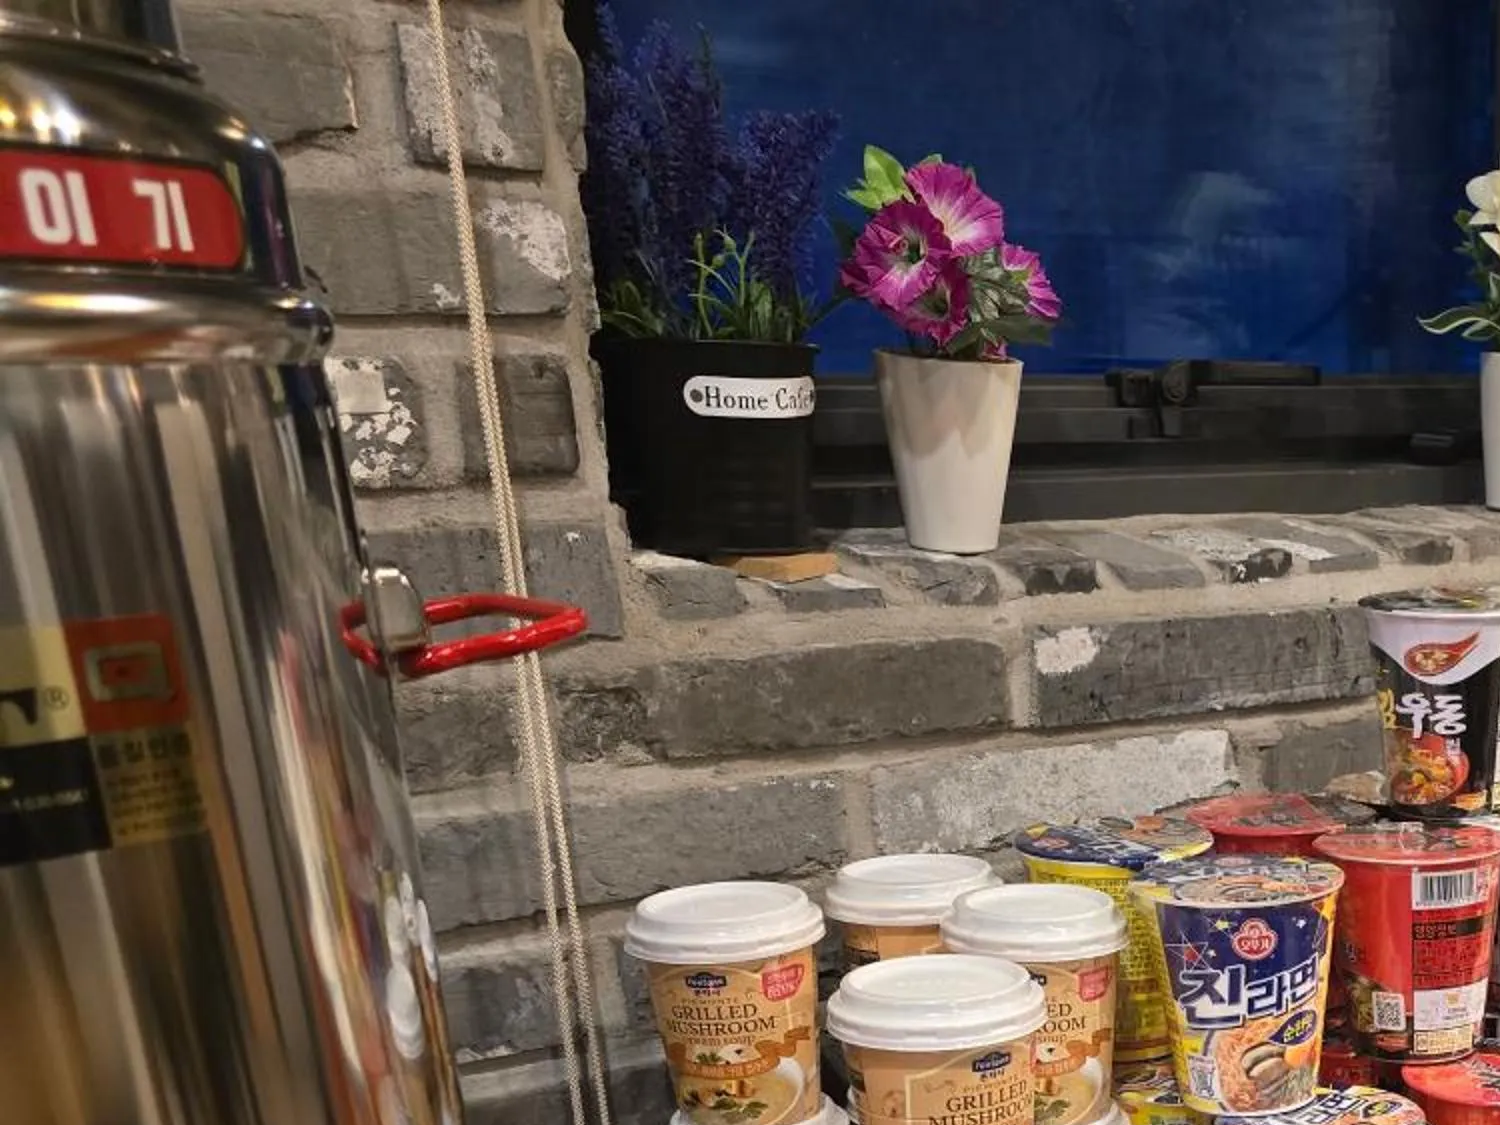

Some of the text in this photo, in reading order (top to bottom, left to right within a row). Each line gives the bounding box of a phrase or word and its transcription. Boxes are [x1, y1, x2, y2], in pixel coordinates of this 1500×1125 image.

[704, 385, 769, 410] Home
[1179, 952, 1319, 1030] 진라면
[671, 1003, 758, 1021] GRILLED
[945, 1079, 1027, 1113] GRILLED
